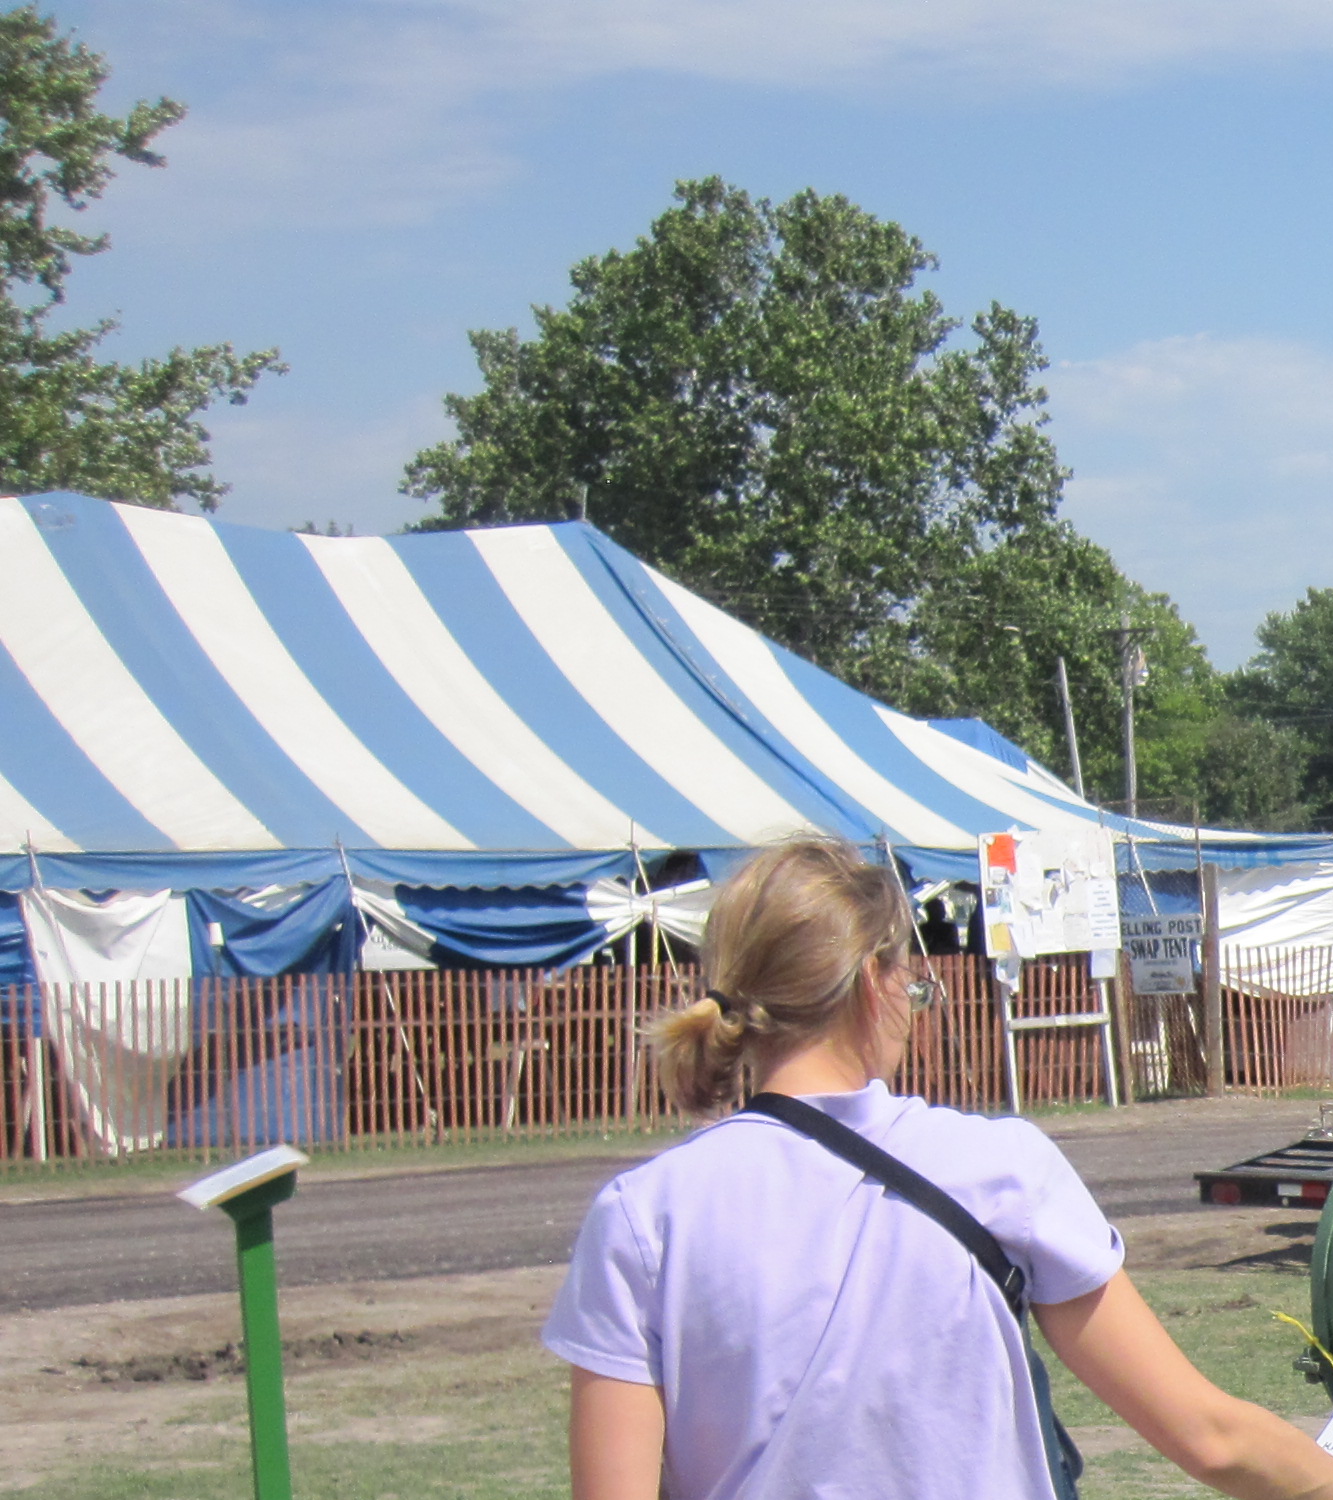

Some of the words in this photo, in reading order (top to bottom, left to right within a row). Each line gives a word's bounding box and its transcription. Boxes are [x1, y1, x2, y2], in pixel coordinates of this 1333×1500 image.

[1168, 919, 1201, 934] POST
[1130, 938, 1160, 960] SWAP
[1162, 937, 1188, 958] TENT
